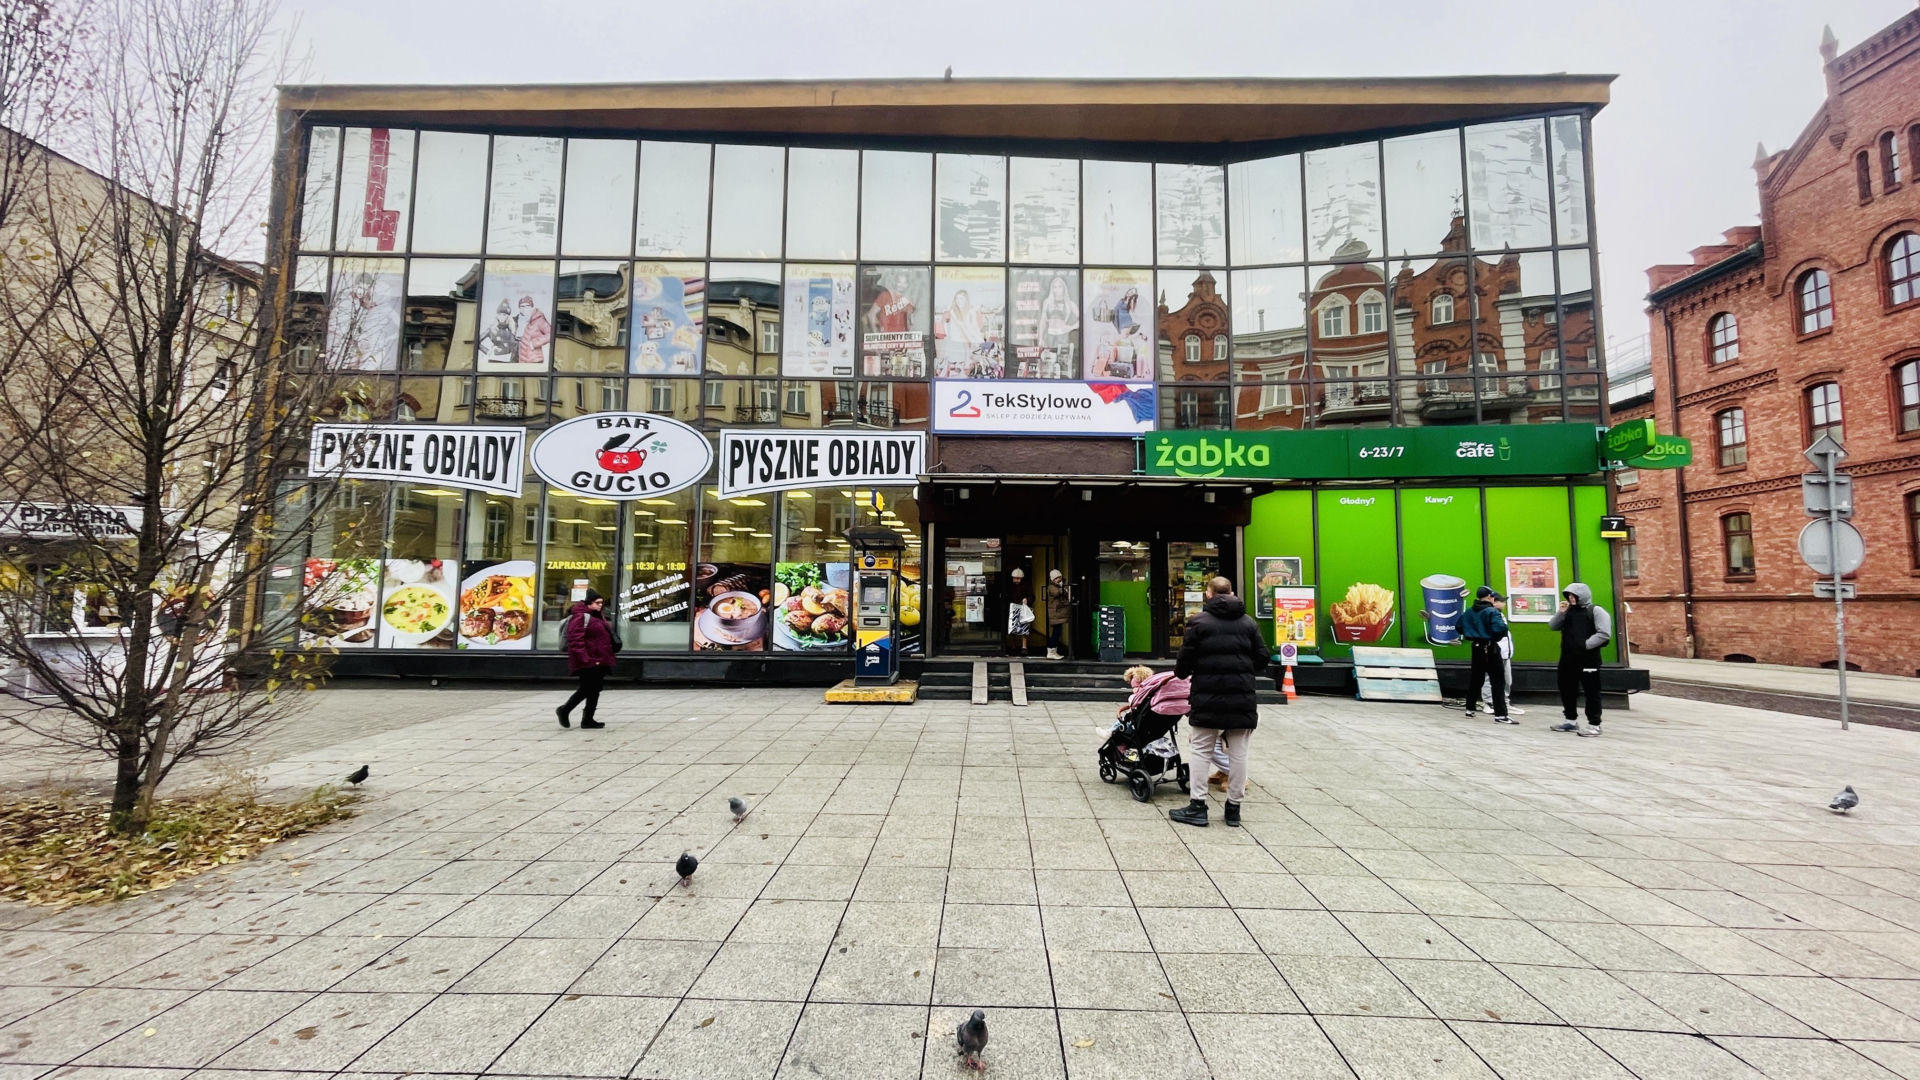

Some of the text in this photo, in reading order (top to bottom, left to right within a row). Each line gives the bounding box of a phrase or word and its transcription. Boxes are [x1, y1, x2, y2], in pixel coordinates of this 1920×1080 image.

[982, 393, 1092, 411] TekStylowo
[597, 417, 650, 430] BAR
[1608, 428, 1643, 449] żabka
[320, 432, 516, 484] PYSZNE OBIADY
[1155, 437, 1270, 467] żabka
[1359, 446, 1405, 458] 6-23/7
[1456, 444, 1494, 458] café
[729, 438, 916, 488] PYSZNE OBIADY
[571, 470, 671, 493] GUCIO
[1339, 497, 1375, 507] Głodny?
[1424, 495, 1454, 504] Kawy?
[1611, 520, 1619, 530] 7
[547, 561, 607, 571] ZAPRASZAMY
[636, 562, 655, 571] 10:30
[666, 562, 686, 571] 18:00
[619, 573, 683, 599] od 22 września
[619, 592, 660, 610] Zapraszamy
[643, 614, 652, 622] w
